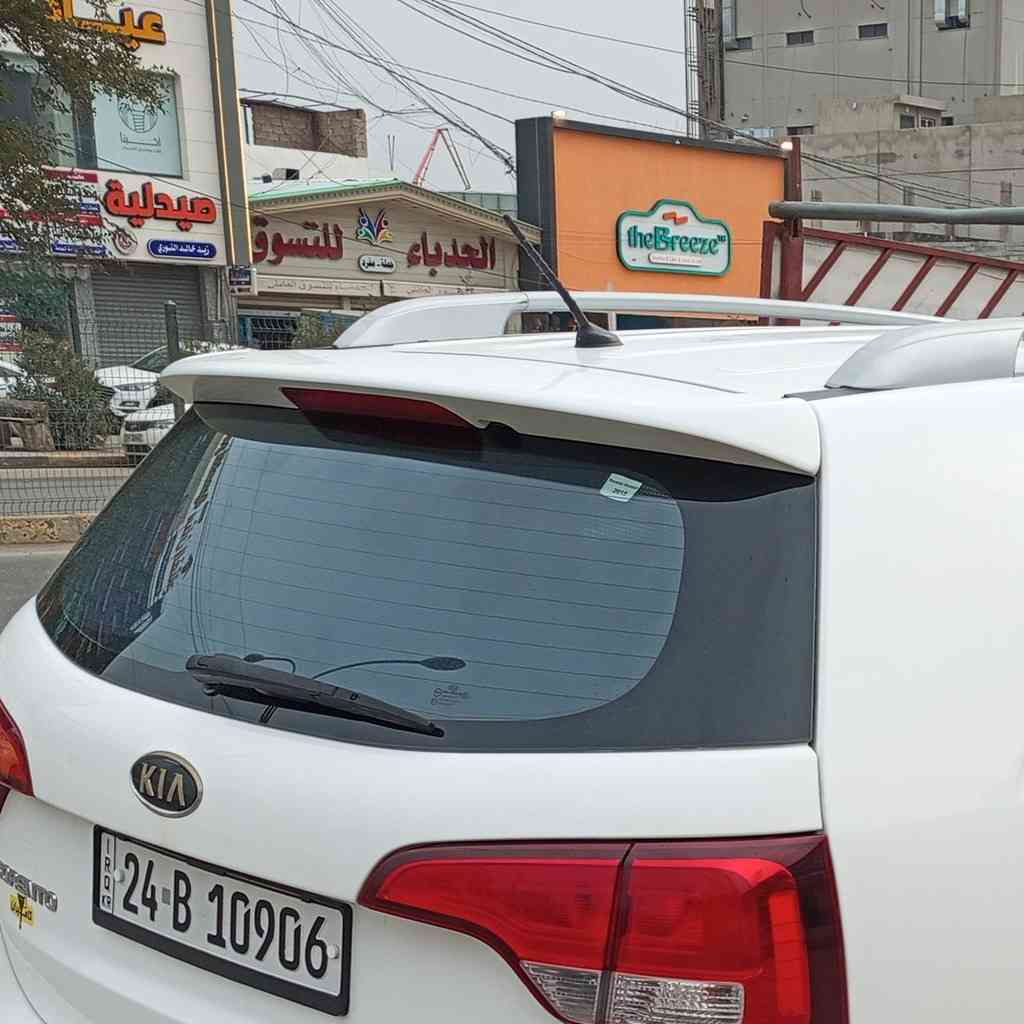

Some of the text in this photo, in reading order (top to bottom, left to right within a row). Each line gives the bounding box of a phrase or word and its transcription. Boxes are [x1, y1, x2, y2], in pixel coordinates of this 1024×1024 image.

[103, 179, 217, 232] صيدلية
[251, 214, 344, 266] للتسوق
[139, 762, 186, 808] KIA
[123, 852, 328, 979] 24 B 10906
